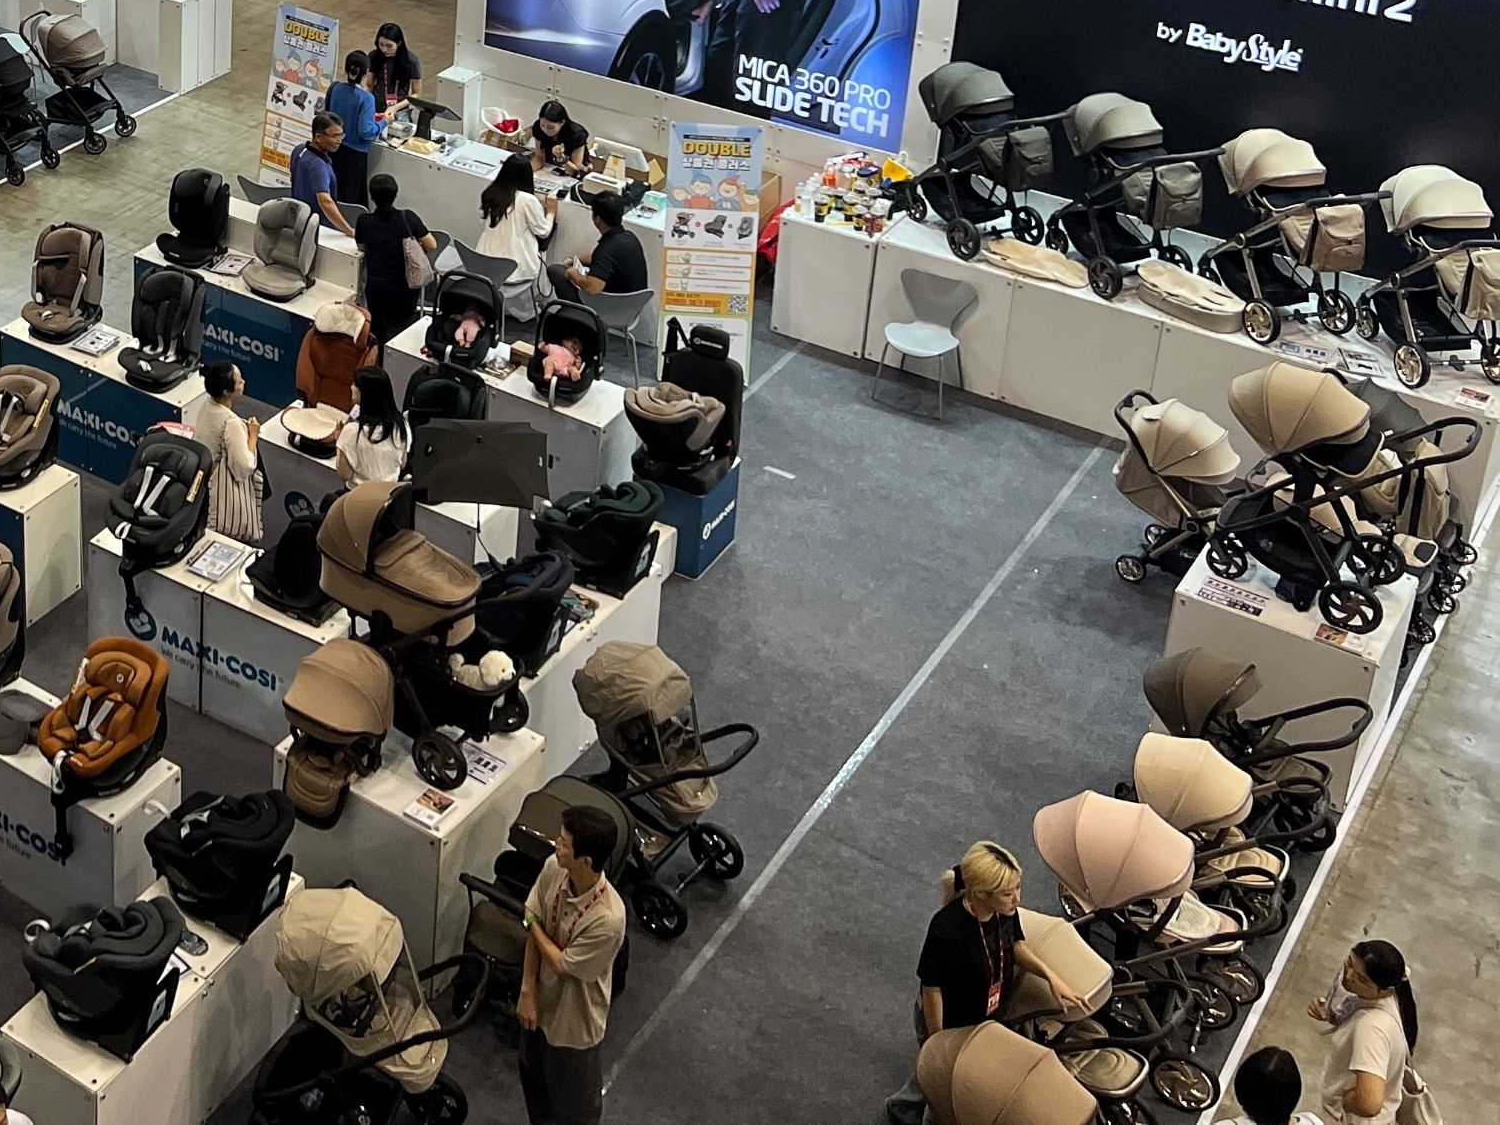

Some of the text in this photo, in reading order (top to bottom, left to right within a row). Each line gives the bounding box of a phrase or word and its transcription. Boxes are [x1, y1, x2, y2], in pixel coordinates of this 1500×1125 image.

[284, 20, 330, 46] DOUBLE
[1156, 21, 1304, 73] by BabyStyle
[734, 75, 890, 138] SLIDE TECH
[738, 53, 892, 110] MICA 360 PRO
[682, 140, 752, 158] DOUBLE
